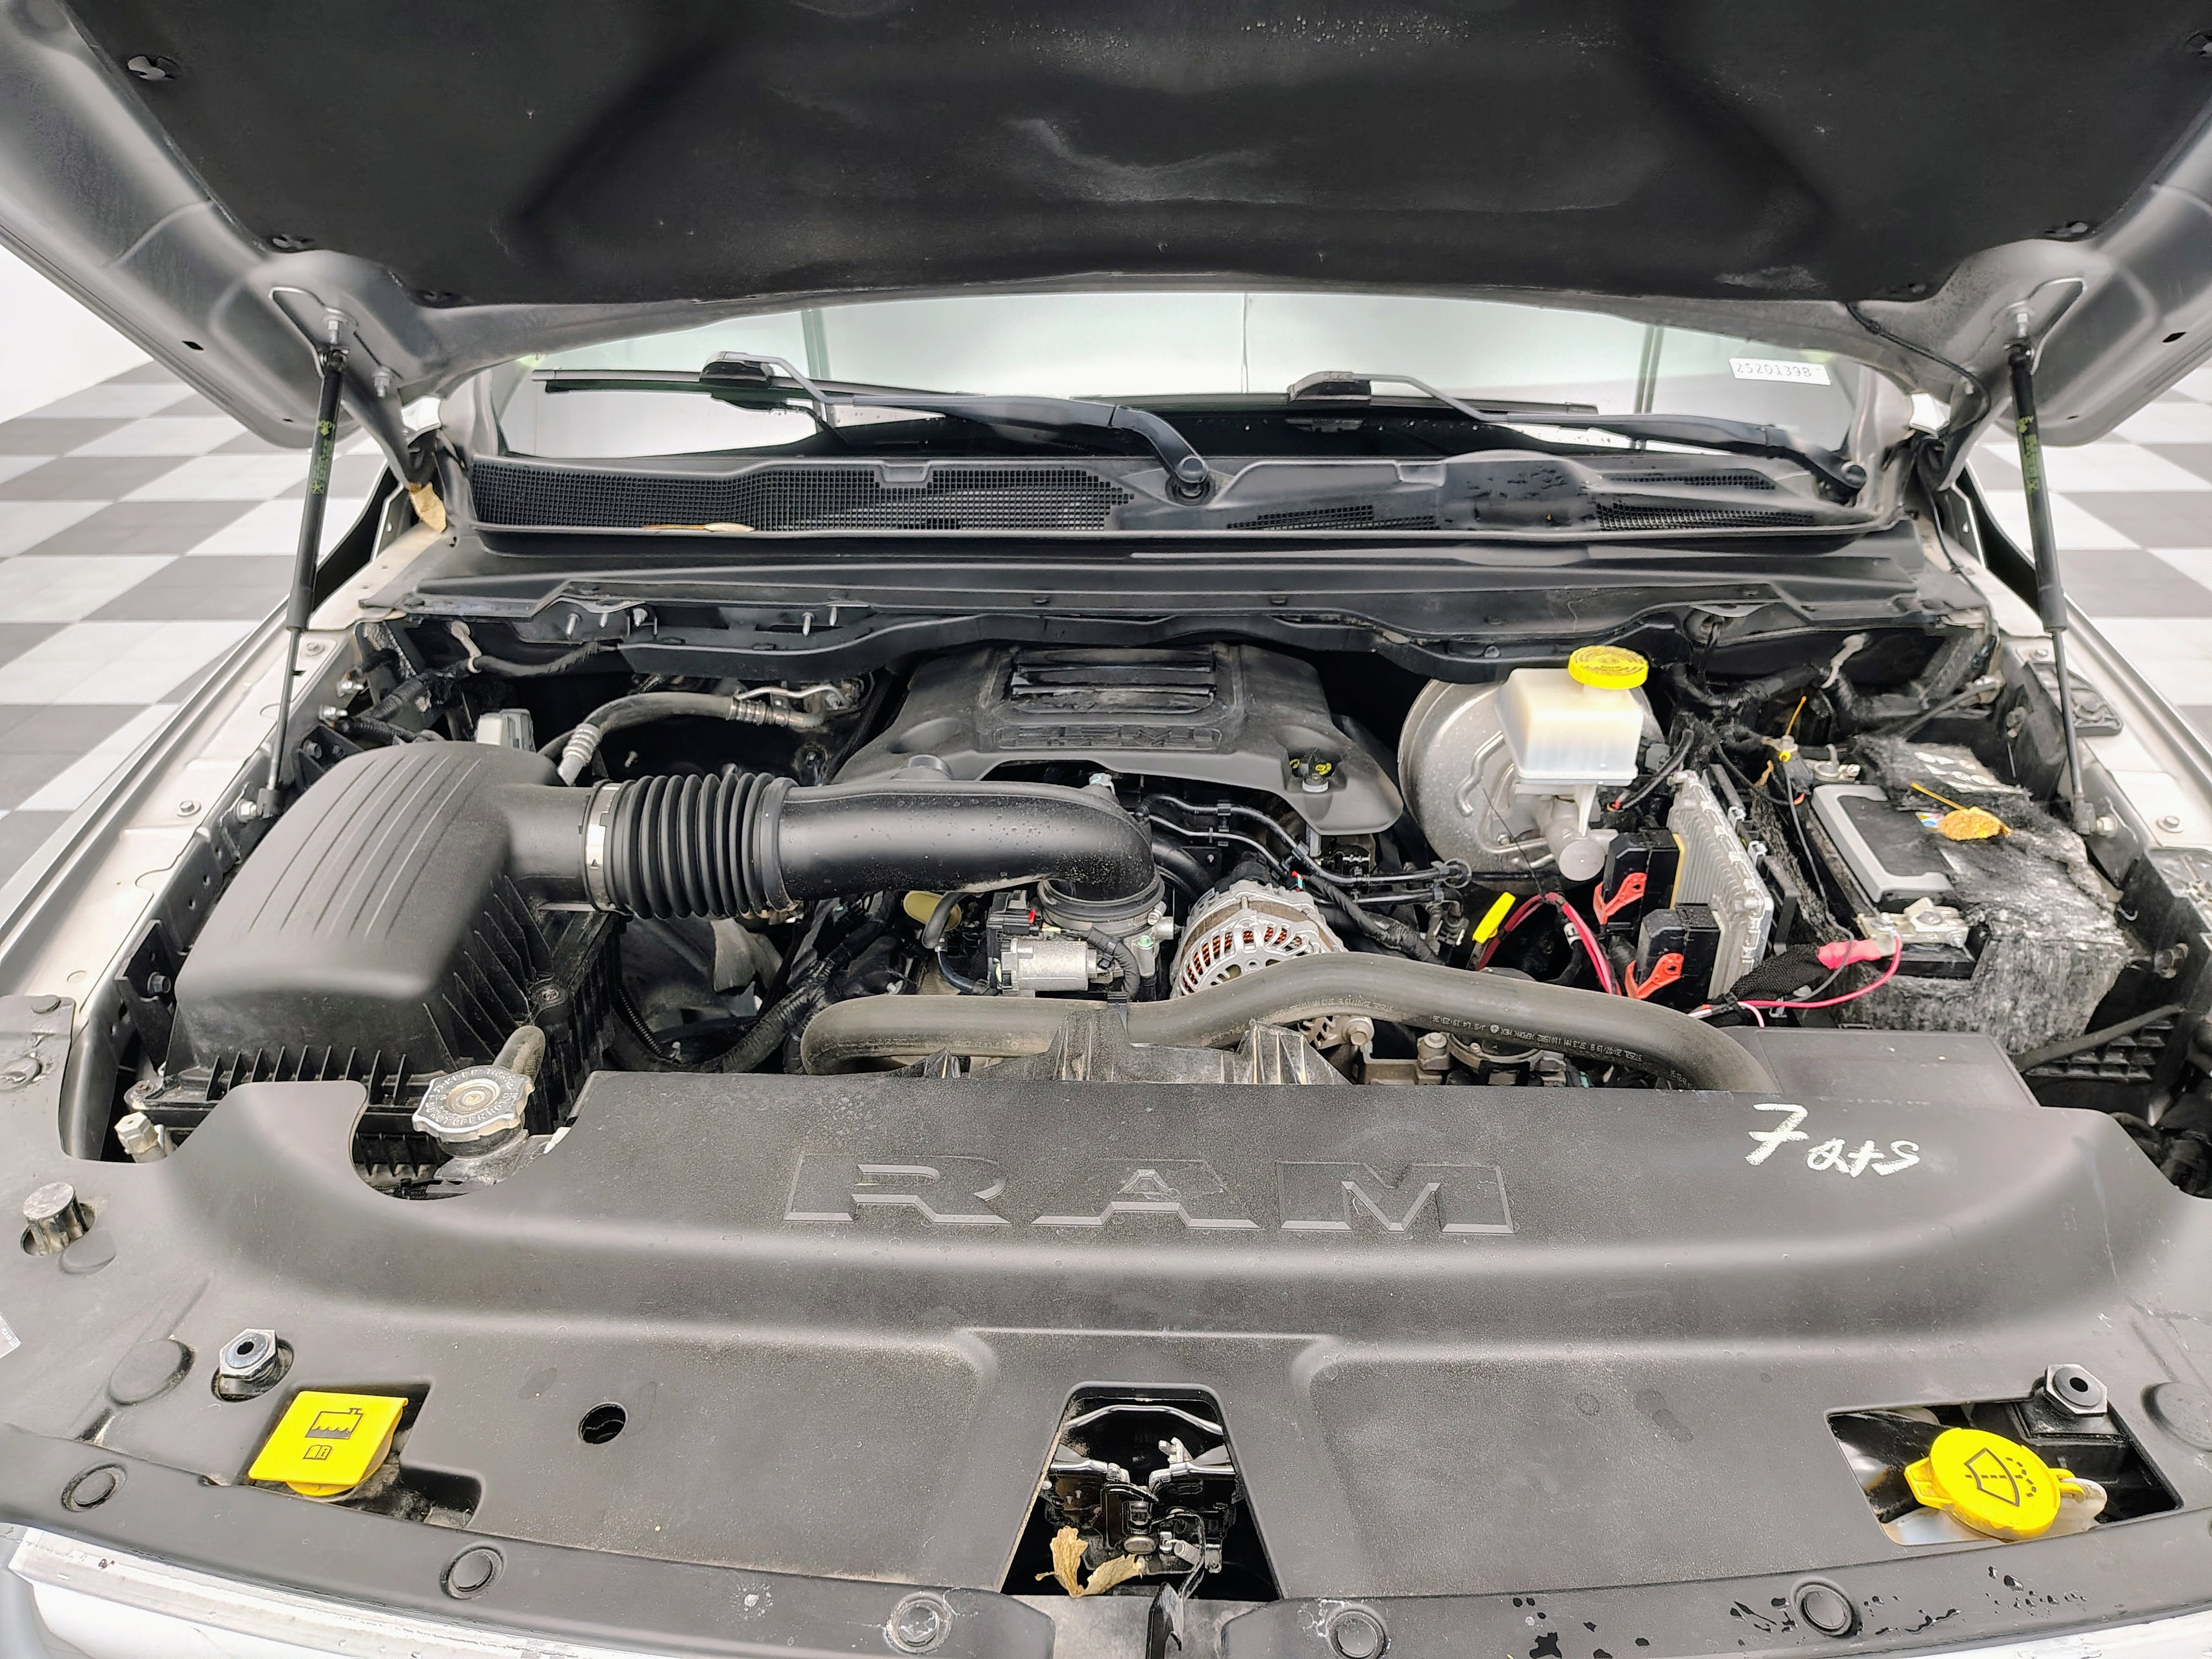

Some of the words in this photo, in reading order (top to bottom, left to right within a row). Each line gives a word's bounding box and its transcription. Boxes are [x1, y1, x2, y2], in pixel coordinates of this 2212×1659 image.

[1737, 362, 1812, 377] 25201398
[444, 1069, 479, 1085] KEEP
[452, 1113, 486, 1126] OPEN
[1745, 1102, 1810, 1166] 7
[784, 1152, 1515, 1235] RAM
